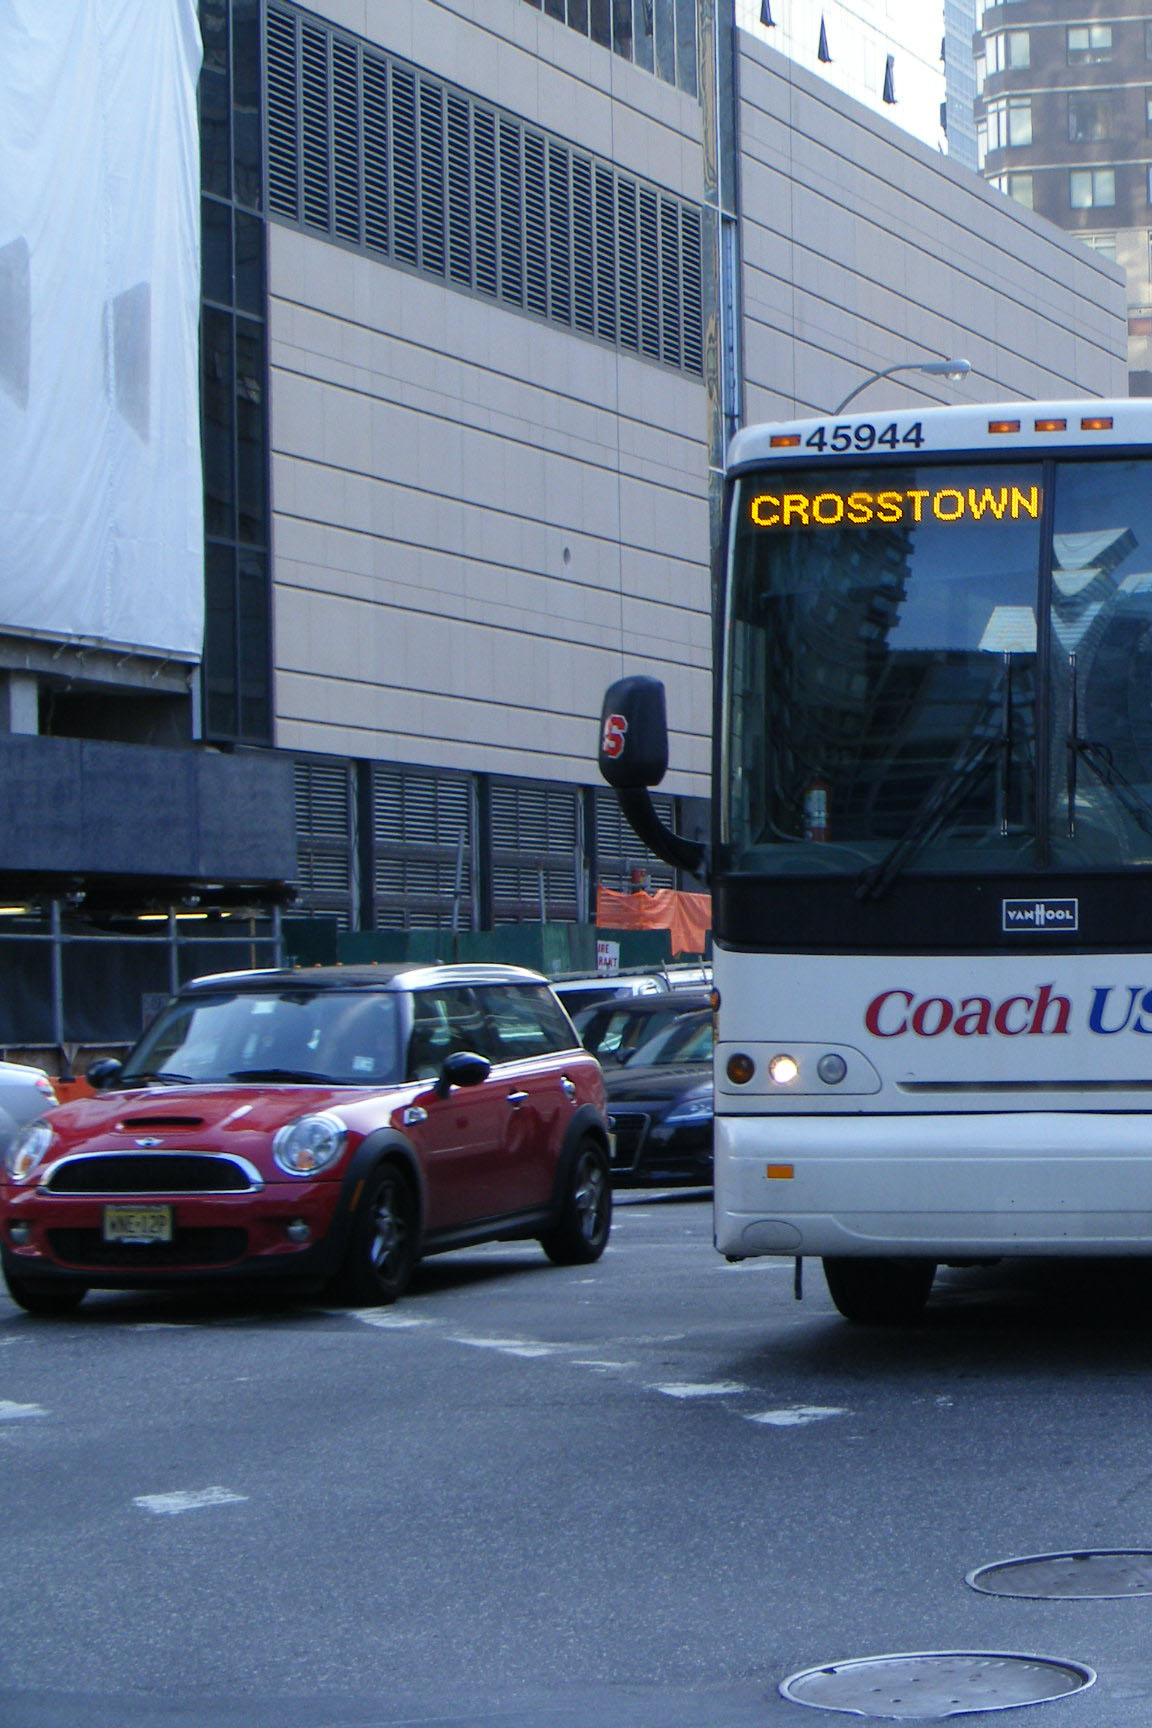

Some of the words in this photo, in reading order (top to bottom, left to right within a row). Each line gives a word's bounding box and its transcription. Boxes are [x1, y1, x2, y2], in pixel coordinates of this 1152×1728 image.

[805, 421, 925, 452] 45944
[751, 486, 1039, 527] CROSSTOWN
[603, 714, 628, 759] S
[863, 982, 1072, 1037] Coach
